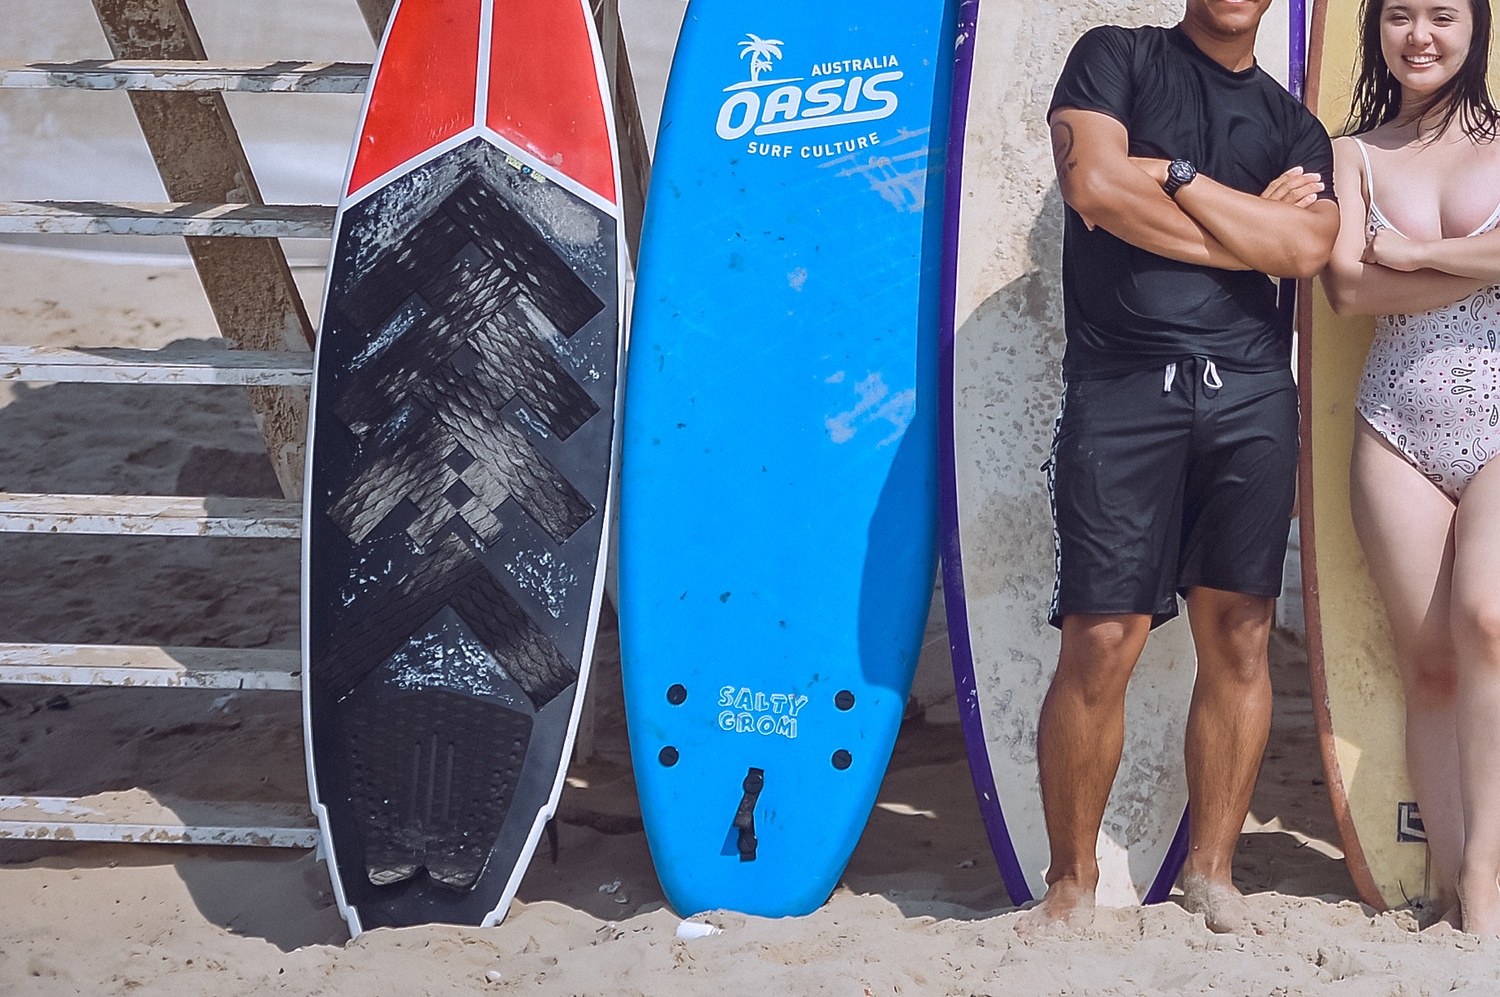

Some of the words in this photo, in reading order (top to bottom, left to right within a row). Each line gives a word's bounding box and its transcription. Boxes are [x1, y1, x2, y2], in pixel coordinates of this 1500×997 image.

[811, 54, 899, 77] AUSTRALIA
[715, 70, 904, 141] OASIS
[747, 141, 793, 158] SURF
[800, 131, 881, 159] CULTURE
[717, 685, 808, 717] SALTY
[718, 710, 798, 739] GROM
